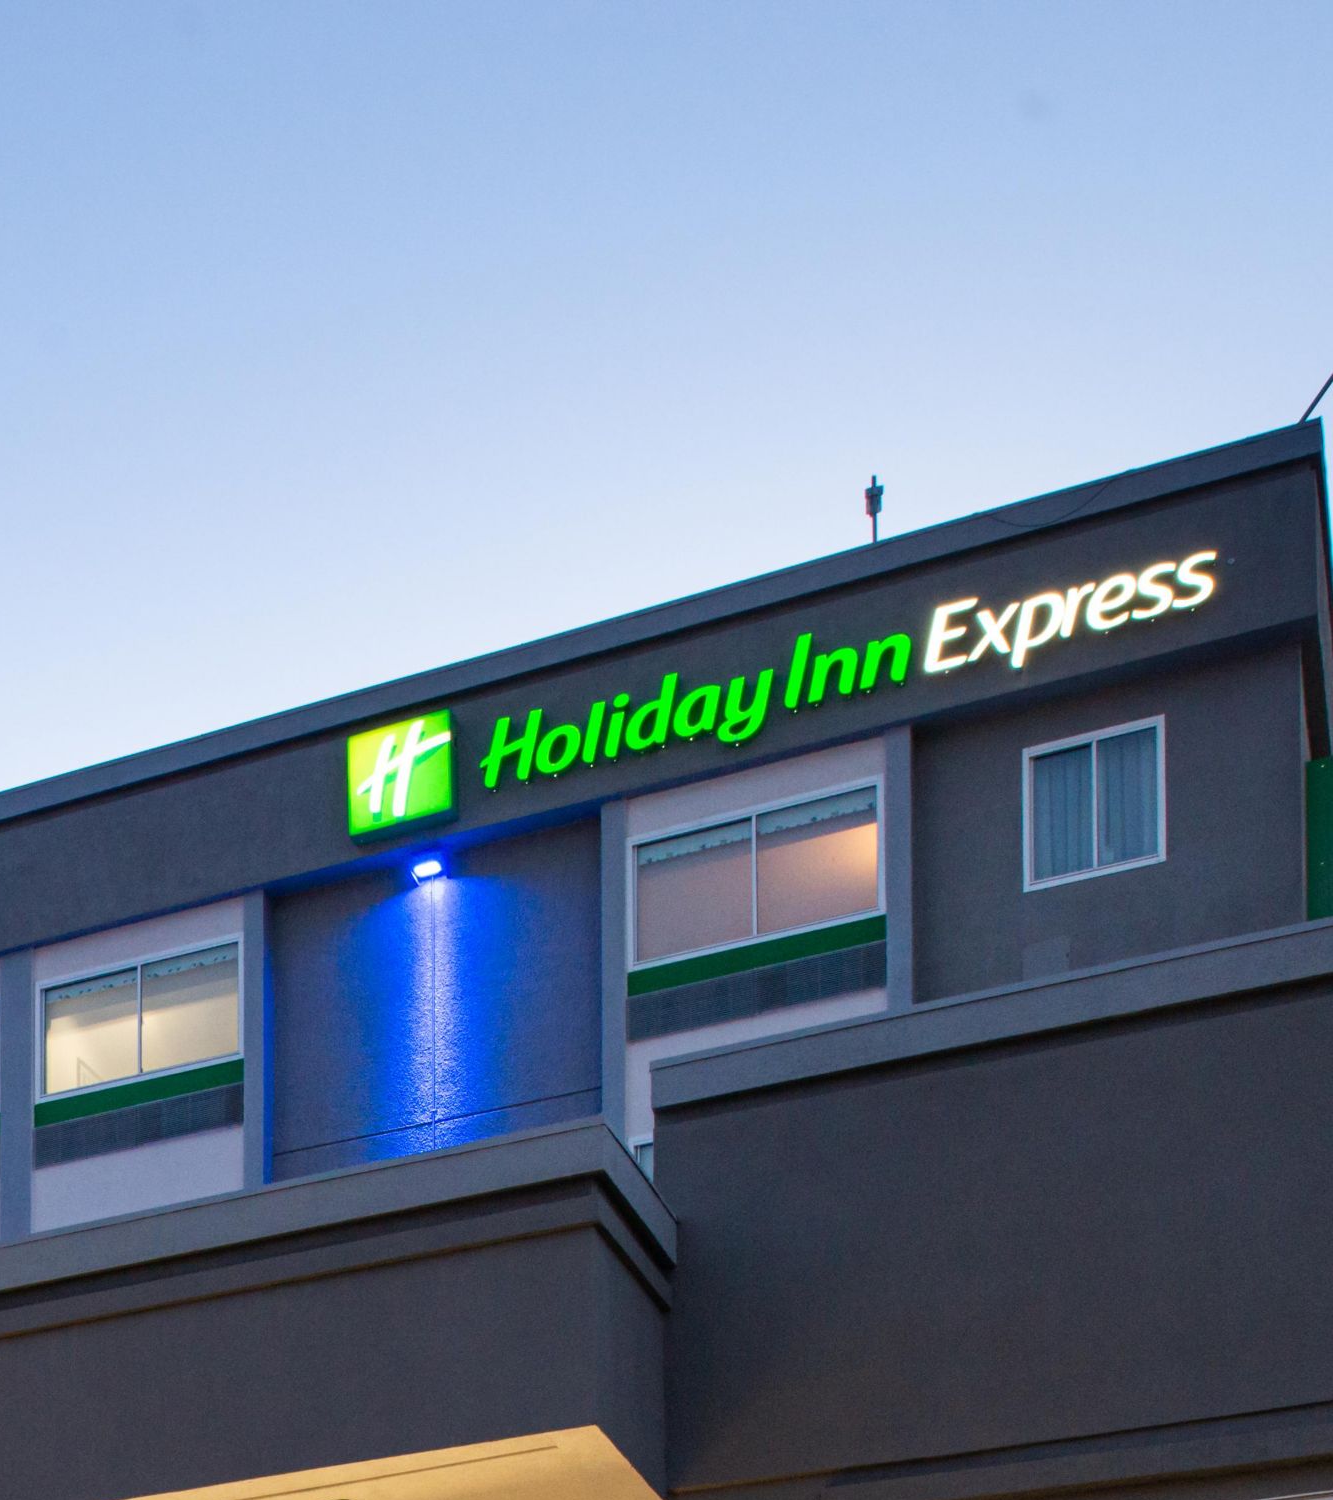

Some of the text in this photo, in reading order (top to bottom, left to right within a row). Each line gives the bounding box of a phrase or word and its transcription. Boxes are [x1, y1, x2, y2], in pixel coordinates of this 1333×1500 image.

[479, 549, 1219, 789] Holiday Inn Express
